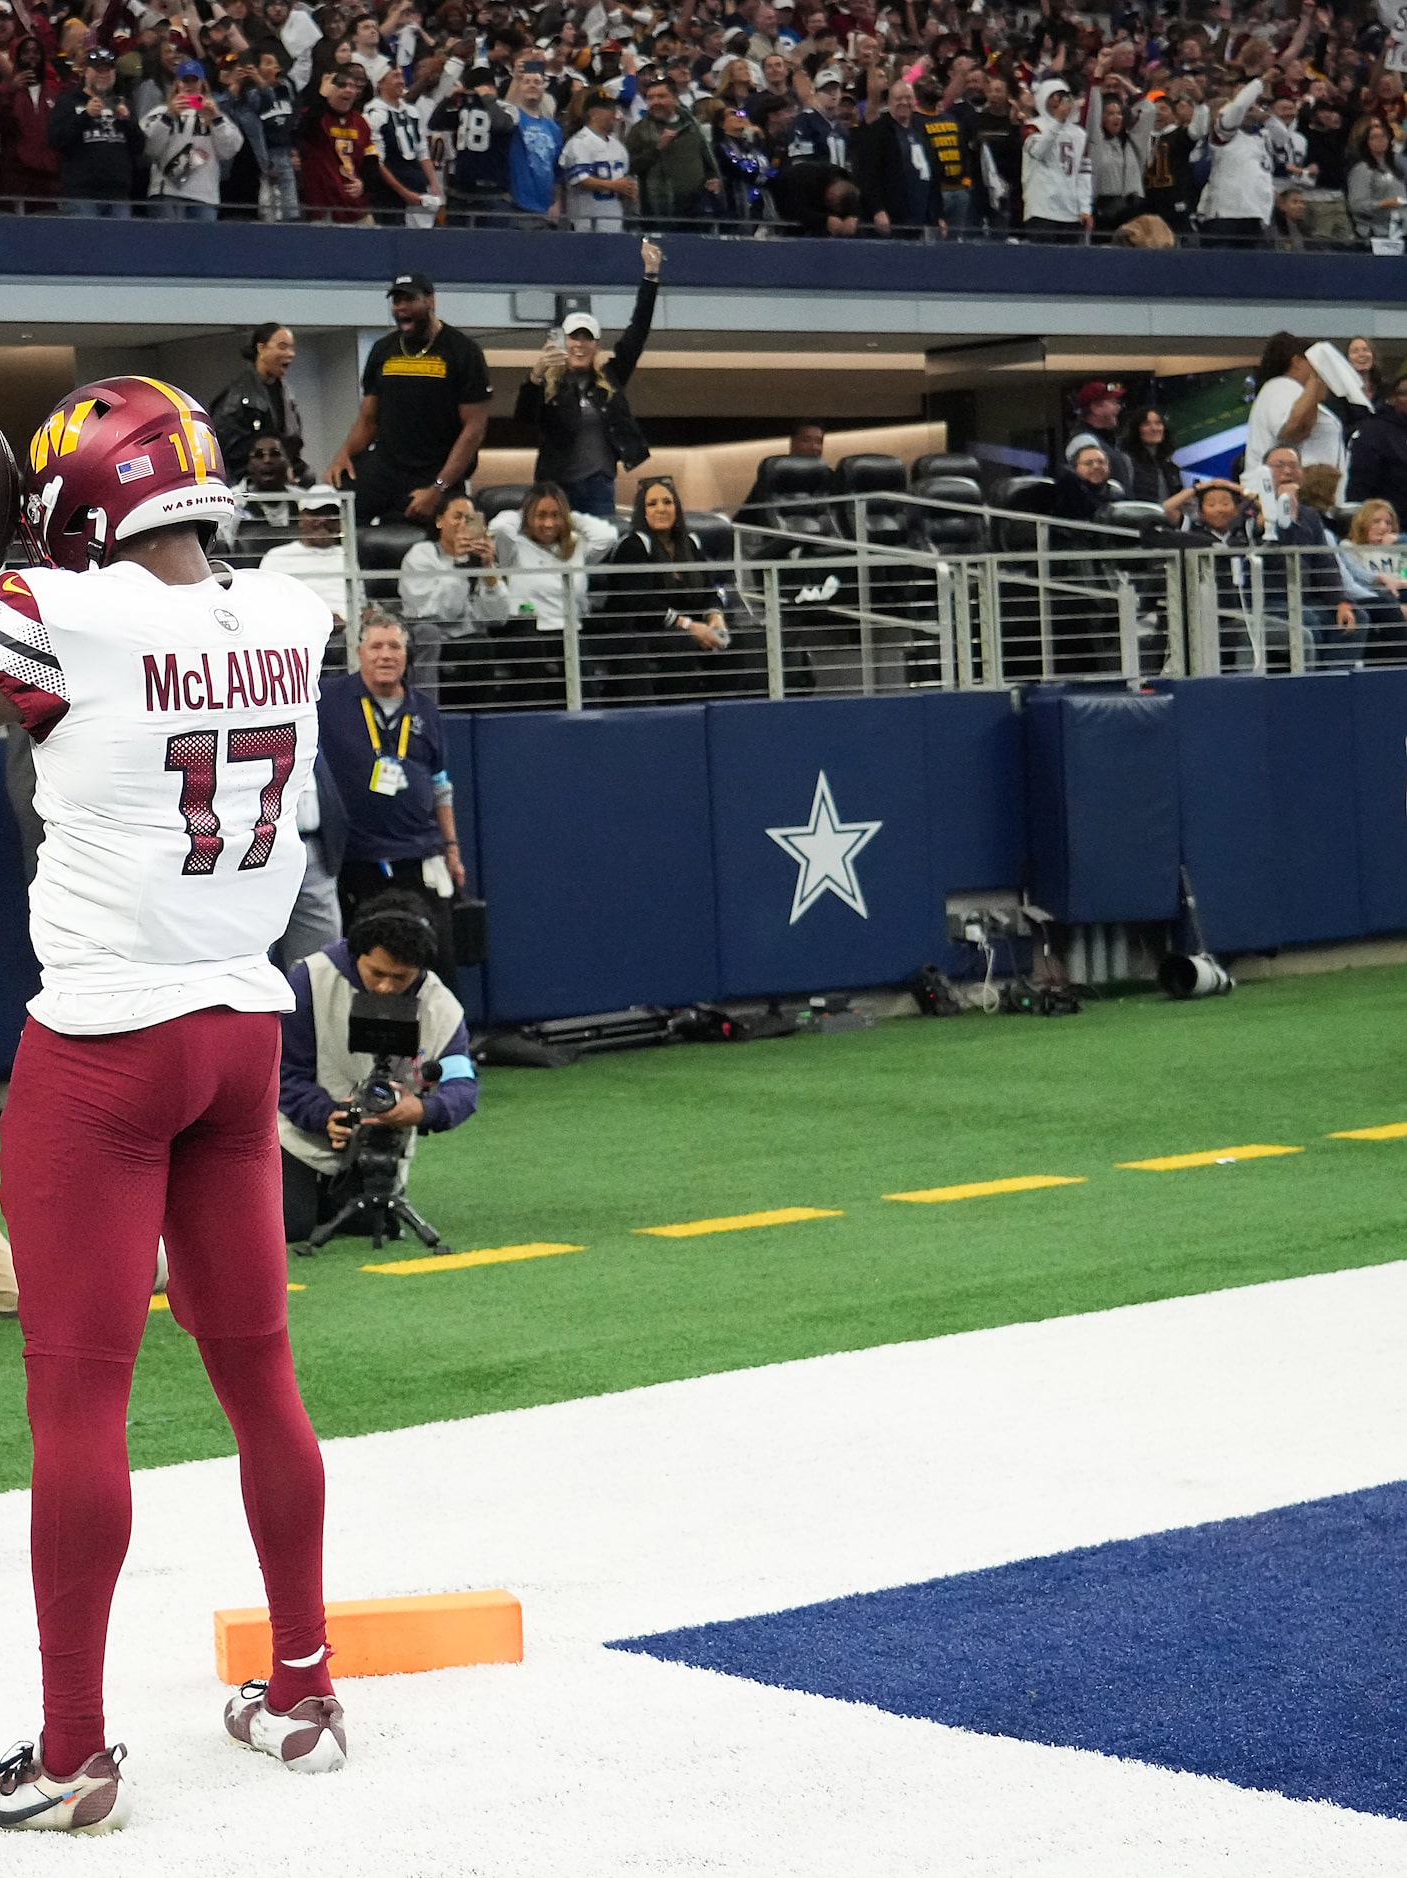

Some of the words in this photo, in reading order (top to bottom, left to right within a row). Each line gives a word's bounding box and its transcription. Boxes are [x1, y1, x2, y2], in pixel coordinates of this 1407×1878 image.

[1059, 141, 1074, 177] 5
[142, 648, 310, 712] McLAURIN
[164, 721, 297, 876] 17
